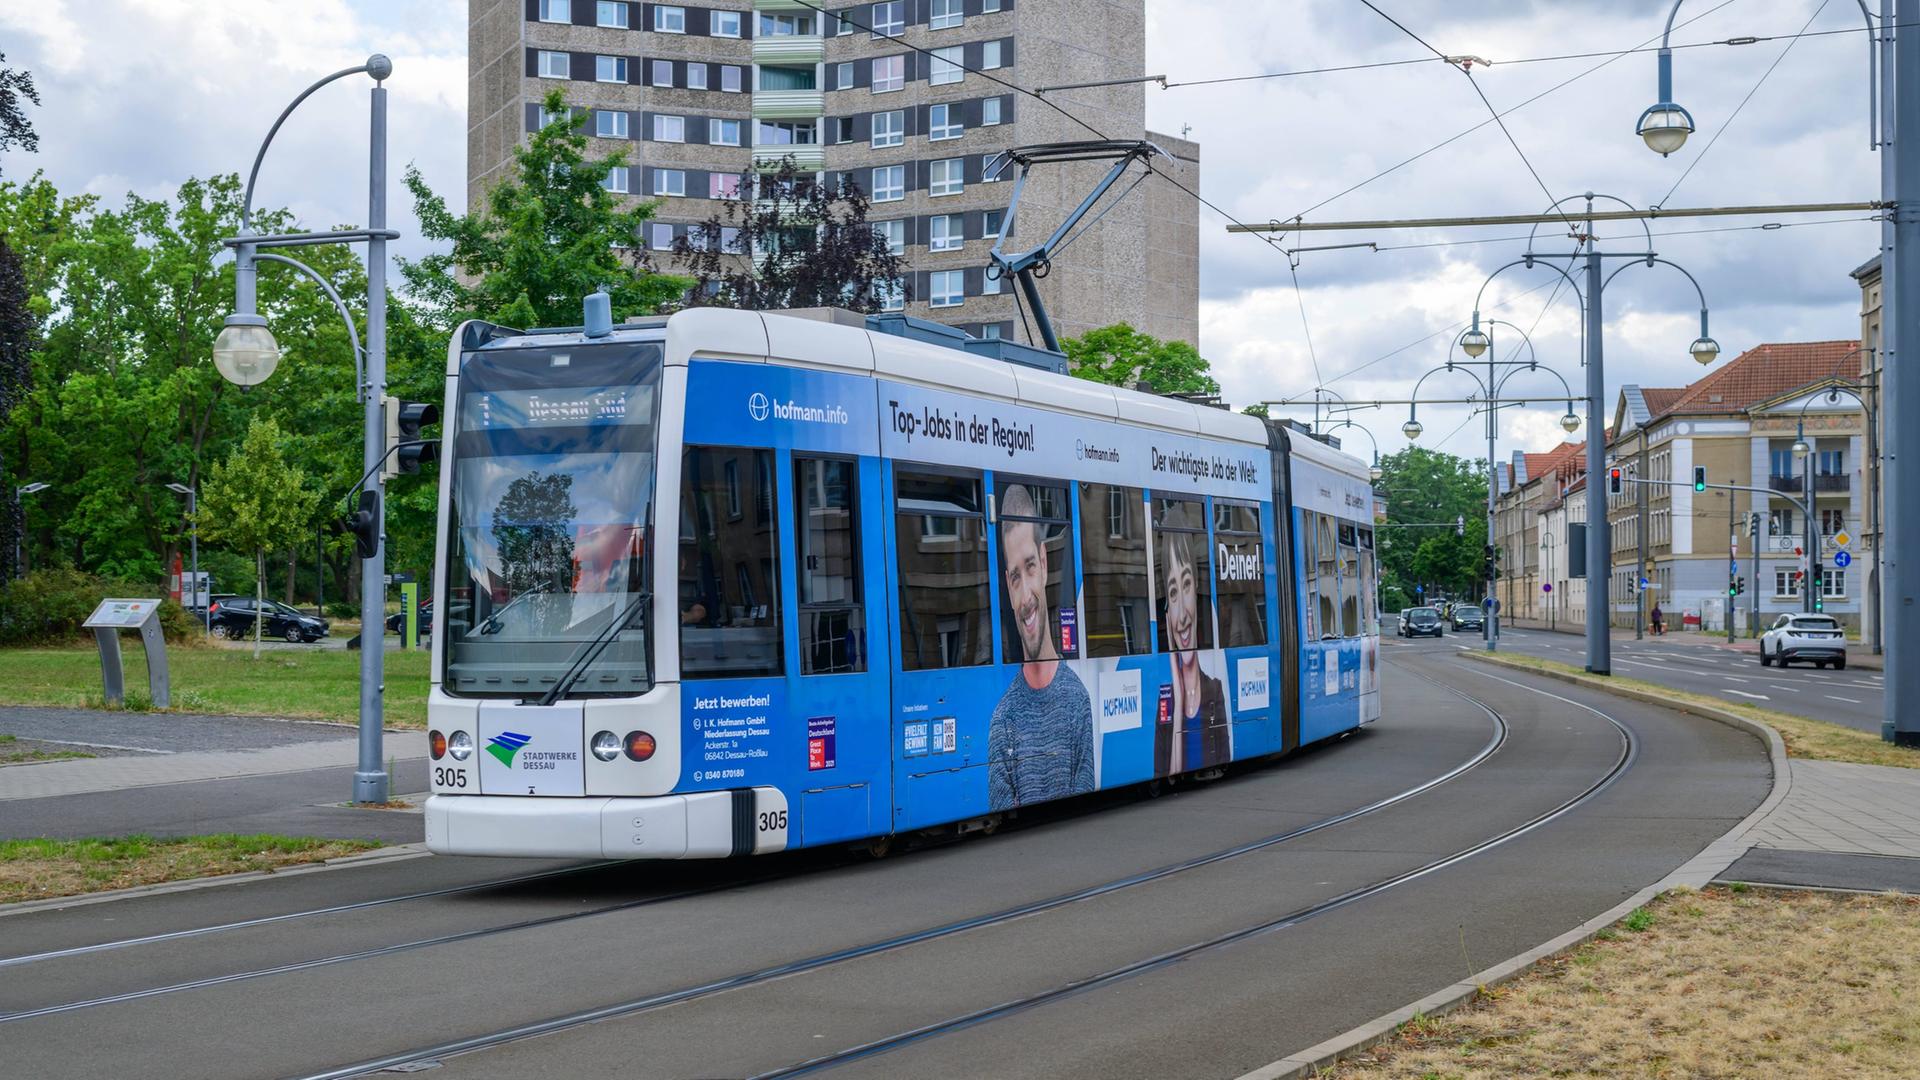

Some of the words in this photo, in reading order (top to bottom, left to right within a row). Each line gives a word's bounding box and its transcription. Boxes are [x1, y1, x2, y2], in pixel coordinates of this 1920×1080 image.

[773, 399, 848, 425] hofmann.info
[889, 400, 952, 443] Top-Jobs
[954, 411, 966, 442] in
[969, 414, 989, 446] der
[992, 417, 1035, 457] Region!
[1084, 443, 1120, 463] hofmann.info
[1151, 446, 1167, 472] Der
[1169, 451, 1209, 483] wichtigste
[1211, 456, 1224, 479] Job
[1225, 459, 1237, 482] der
[1218, 542, 1261, 582] Deiner!
[1240, 680, 1266, 697] HOFMANN
[693, 697, 719, 710] Jetzt
[720, 694, 770, 709] bewerben!
[1103, 695, 1138, 718] HOFMANN
[710, 719, 717, 728] K.
[717, 718, 746, 728] Hofmann
[746, 716, 766, 726] GmbH
[704, 729, 747, 739] Niederlassung
[748, 728, 770, 737] Dessau
[808, 728, 835, 737] Deutschland
[523, 751, 577, 761] STADTWERKE
[704, 751, 724, 761] 06842
[523, 761, 556, 770] DESSAU
[704, 770, 721, 780] 0340
[722, 768, 745, 779] 870180
[435, 766, 467, 788] 305
[759, 810, 787, 831] 305
